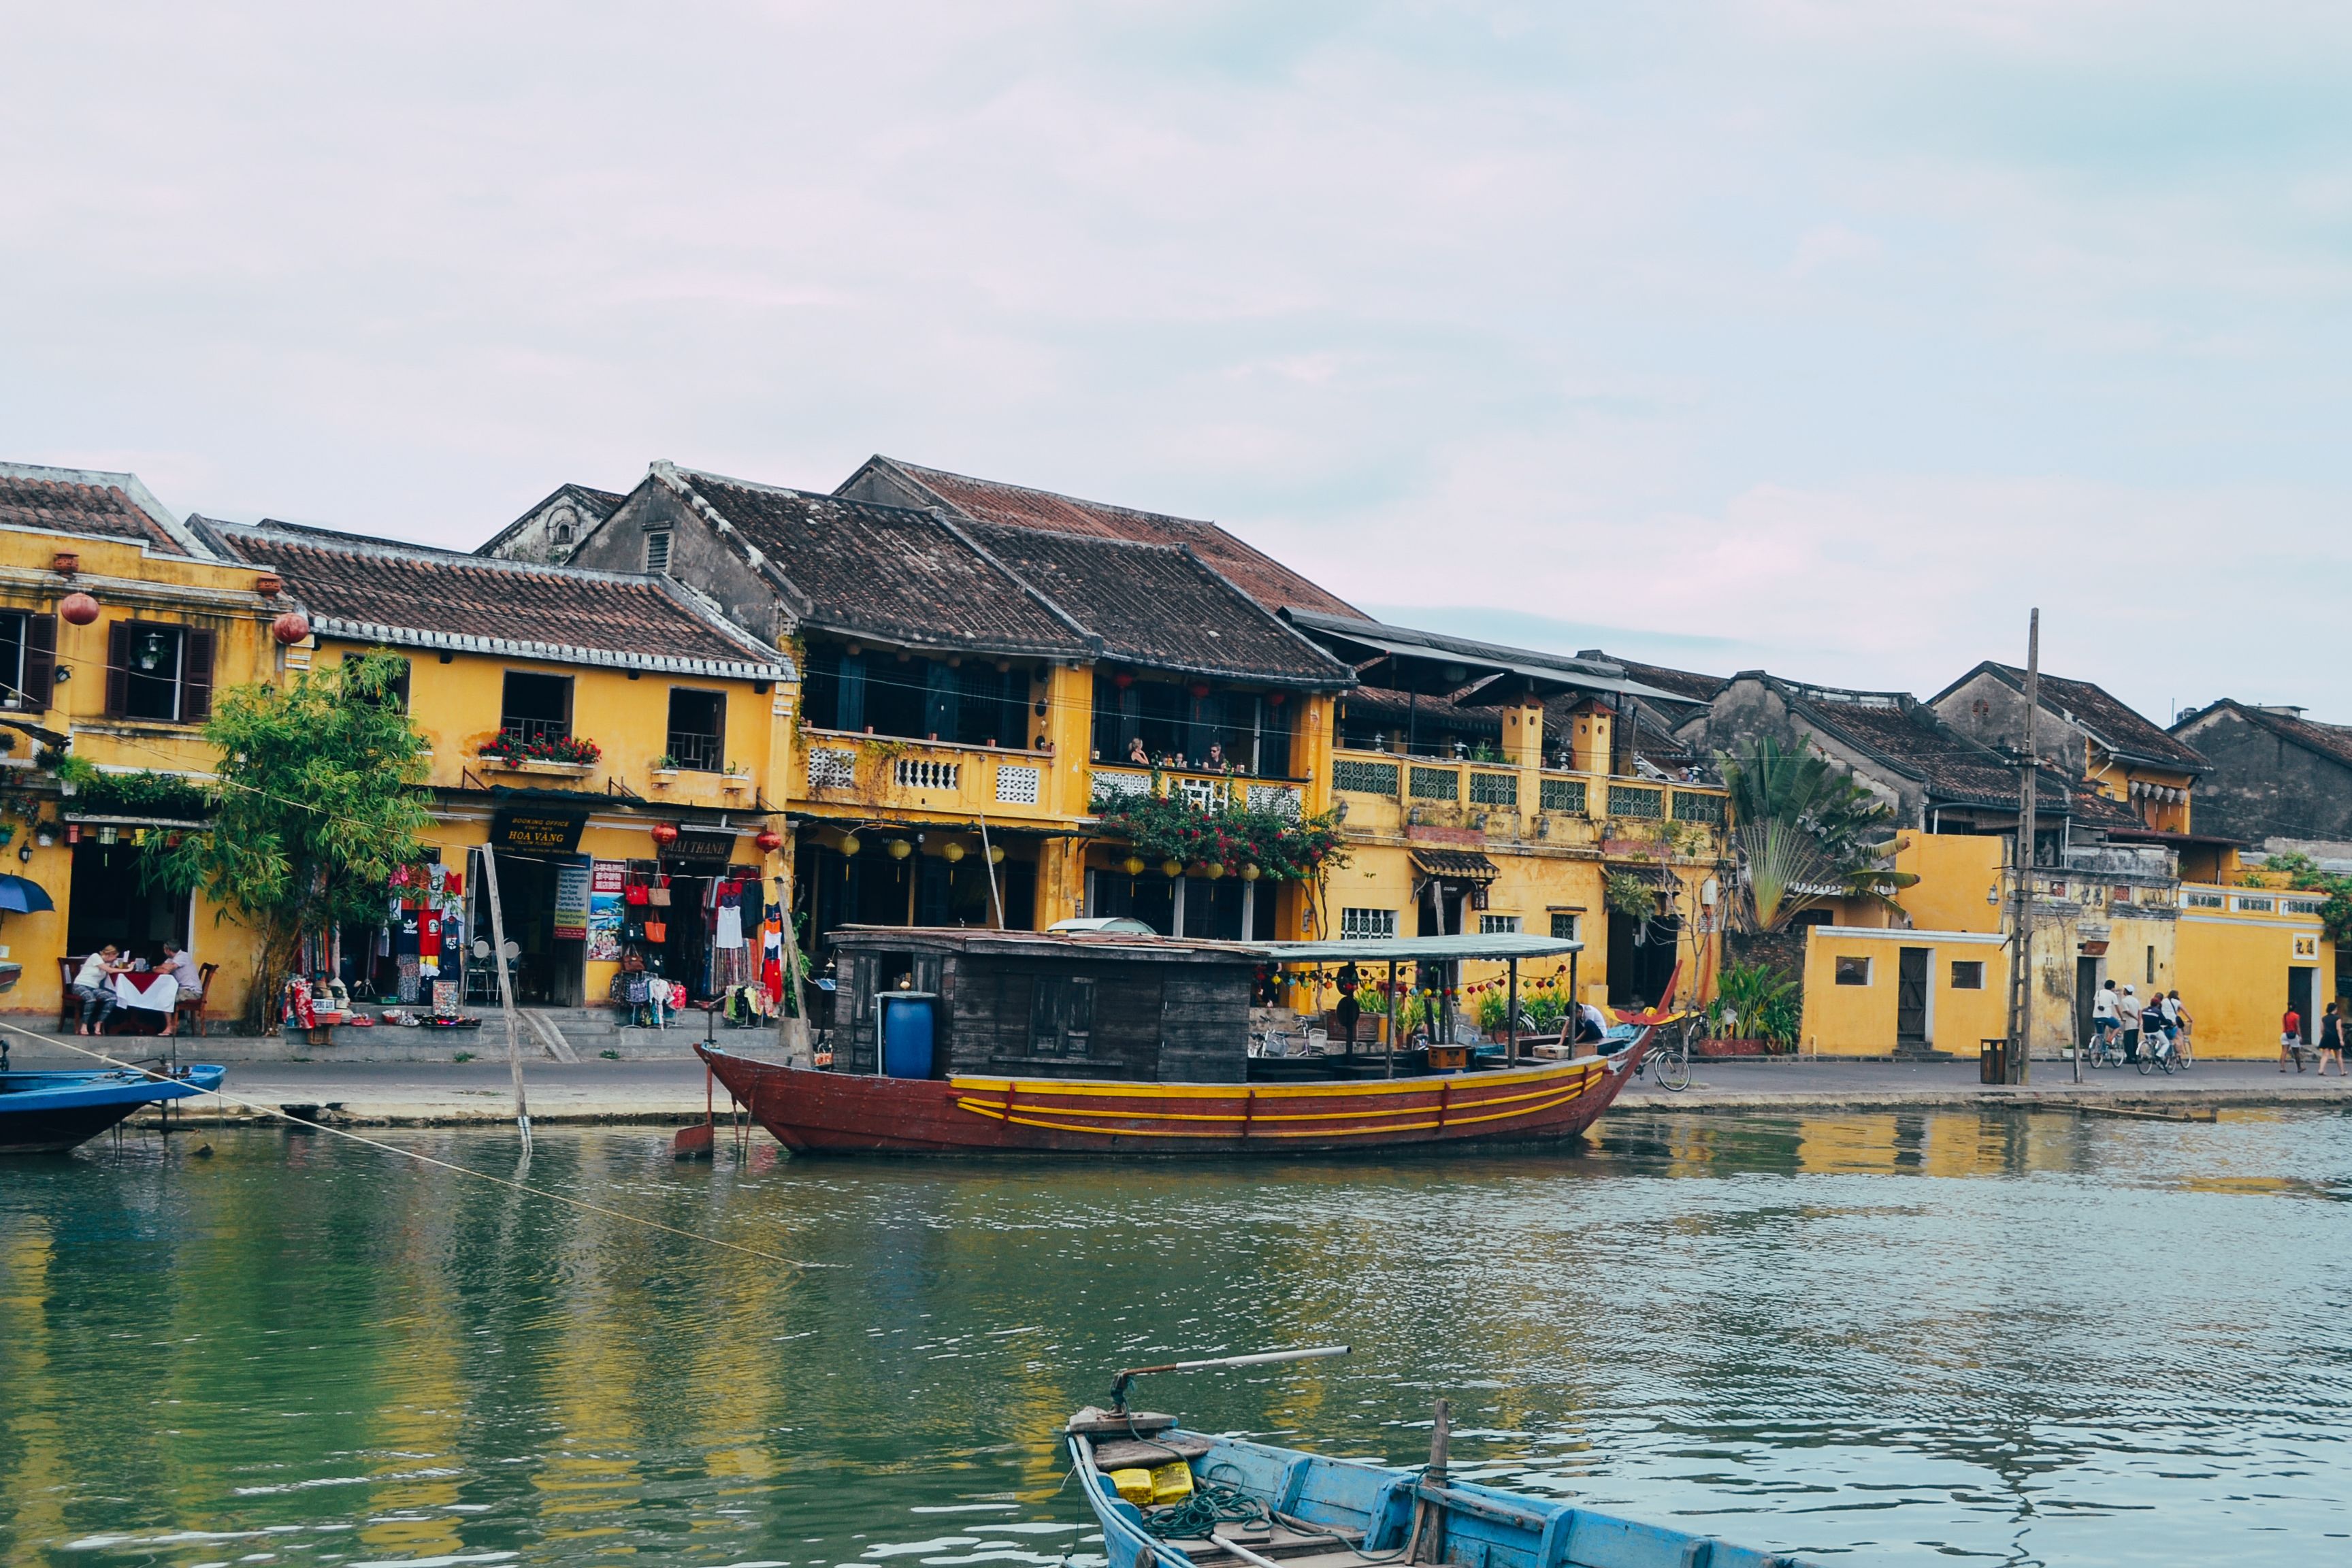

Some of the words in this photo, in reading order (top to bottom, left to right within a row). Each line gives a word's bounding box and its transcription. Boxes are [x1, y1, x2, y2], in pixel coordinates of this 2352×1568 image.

[508, 831, 531, 839] HOA
[535, 832, 564, 843] VÀNG
[690, 841, 726, 854] THANH
